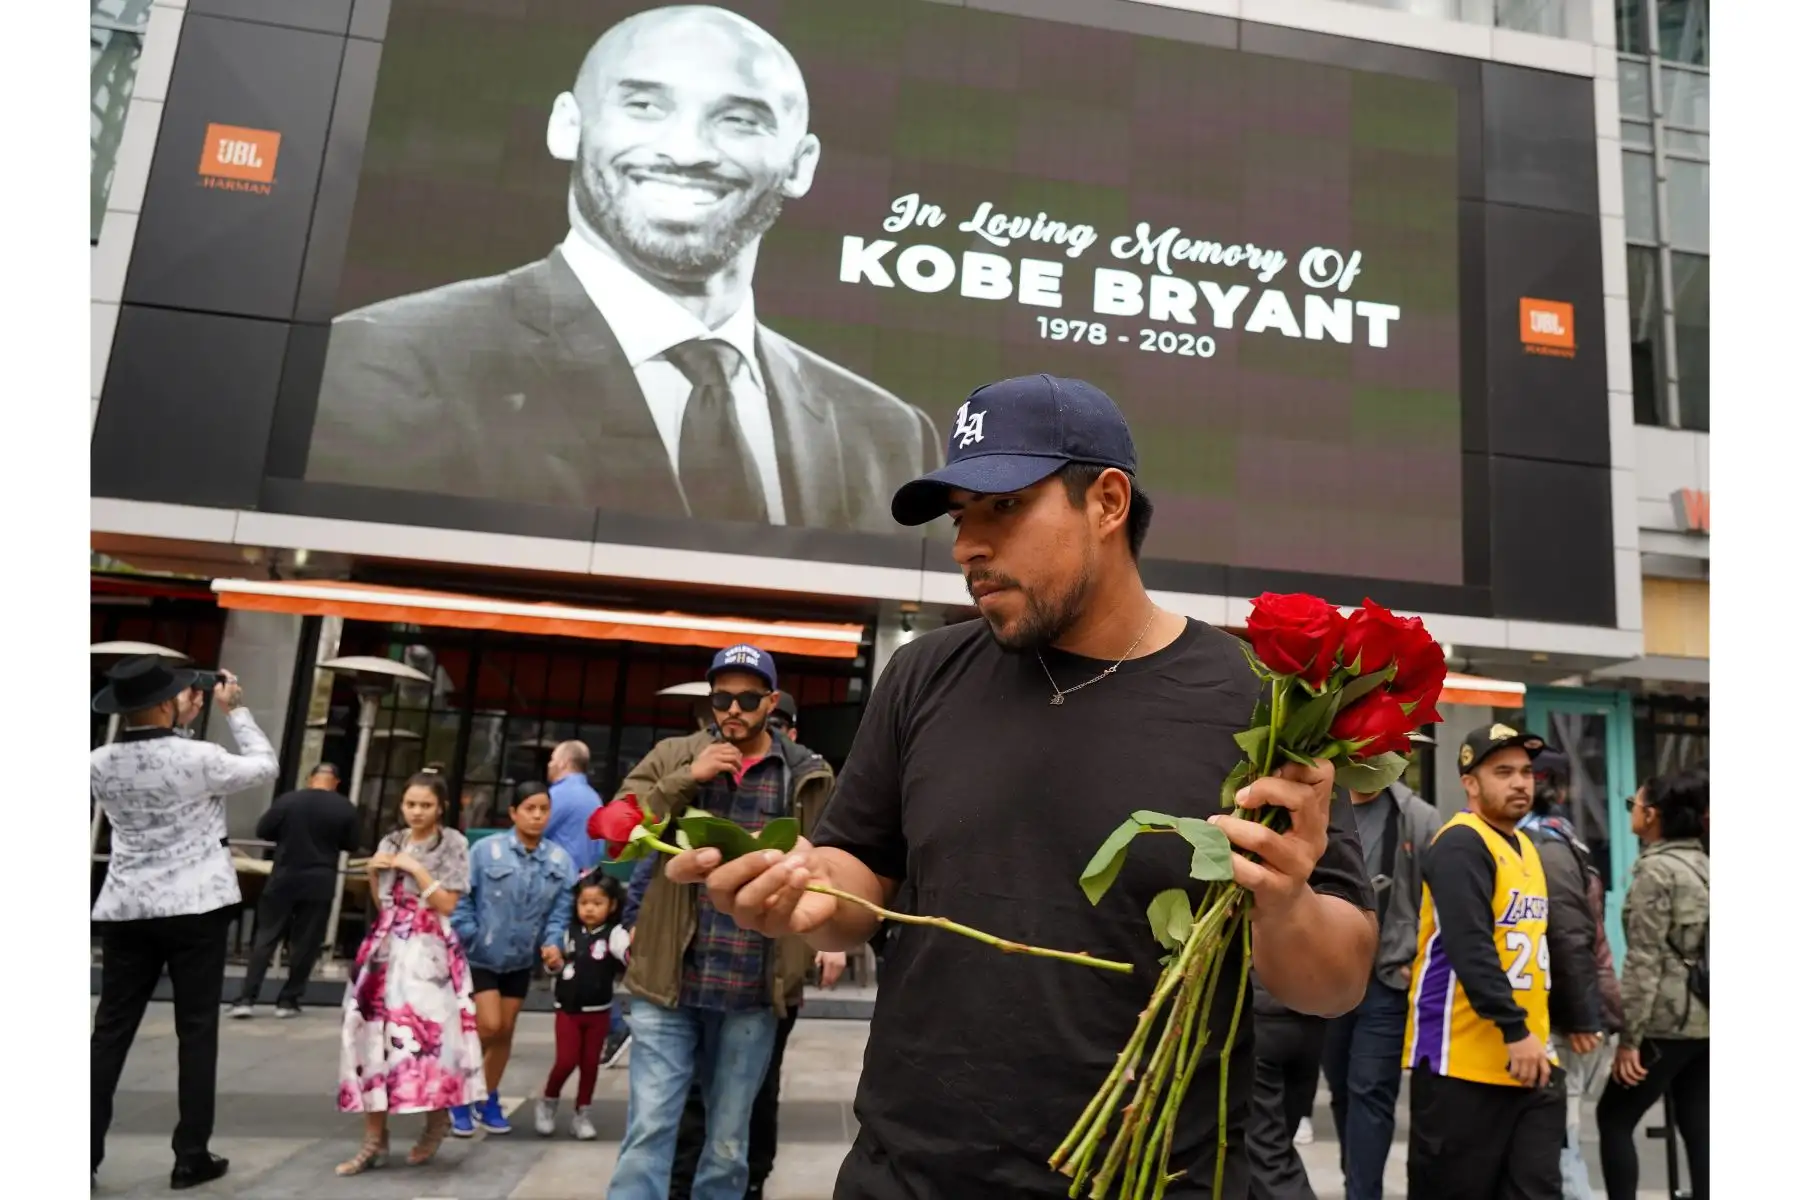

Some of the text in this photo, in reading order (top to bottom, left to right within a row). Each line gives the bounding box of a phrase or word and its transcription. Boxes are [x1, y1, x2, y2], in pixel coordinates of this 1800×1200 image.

[216, 138, 263, 168] JBL
[882, 193, 1362, 293] In Loving Memory Of
[839, 235, 1401, 348] KOBE BRYANT
[1036, 315, 1108, 346] 1978
[1139, 328, 1216, 359] 2020
[953, 401, 988, 450] LA
